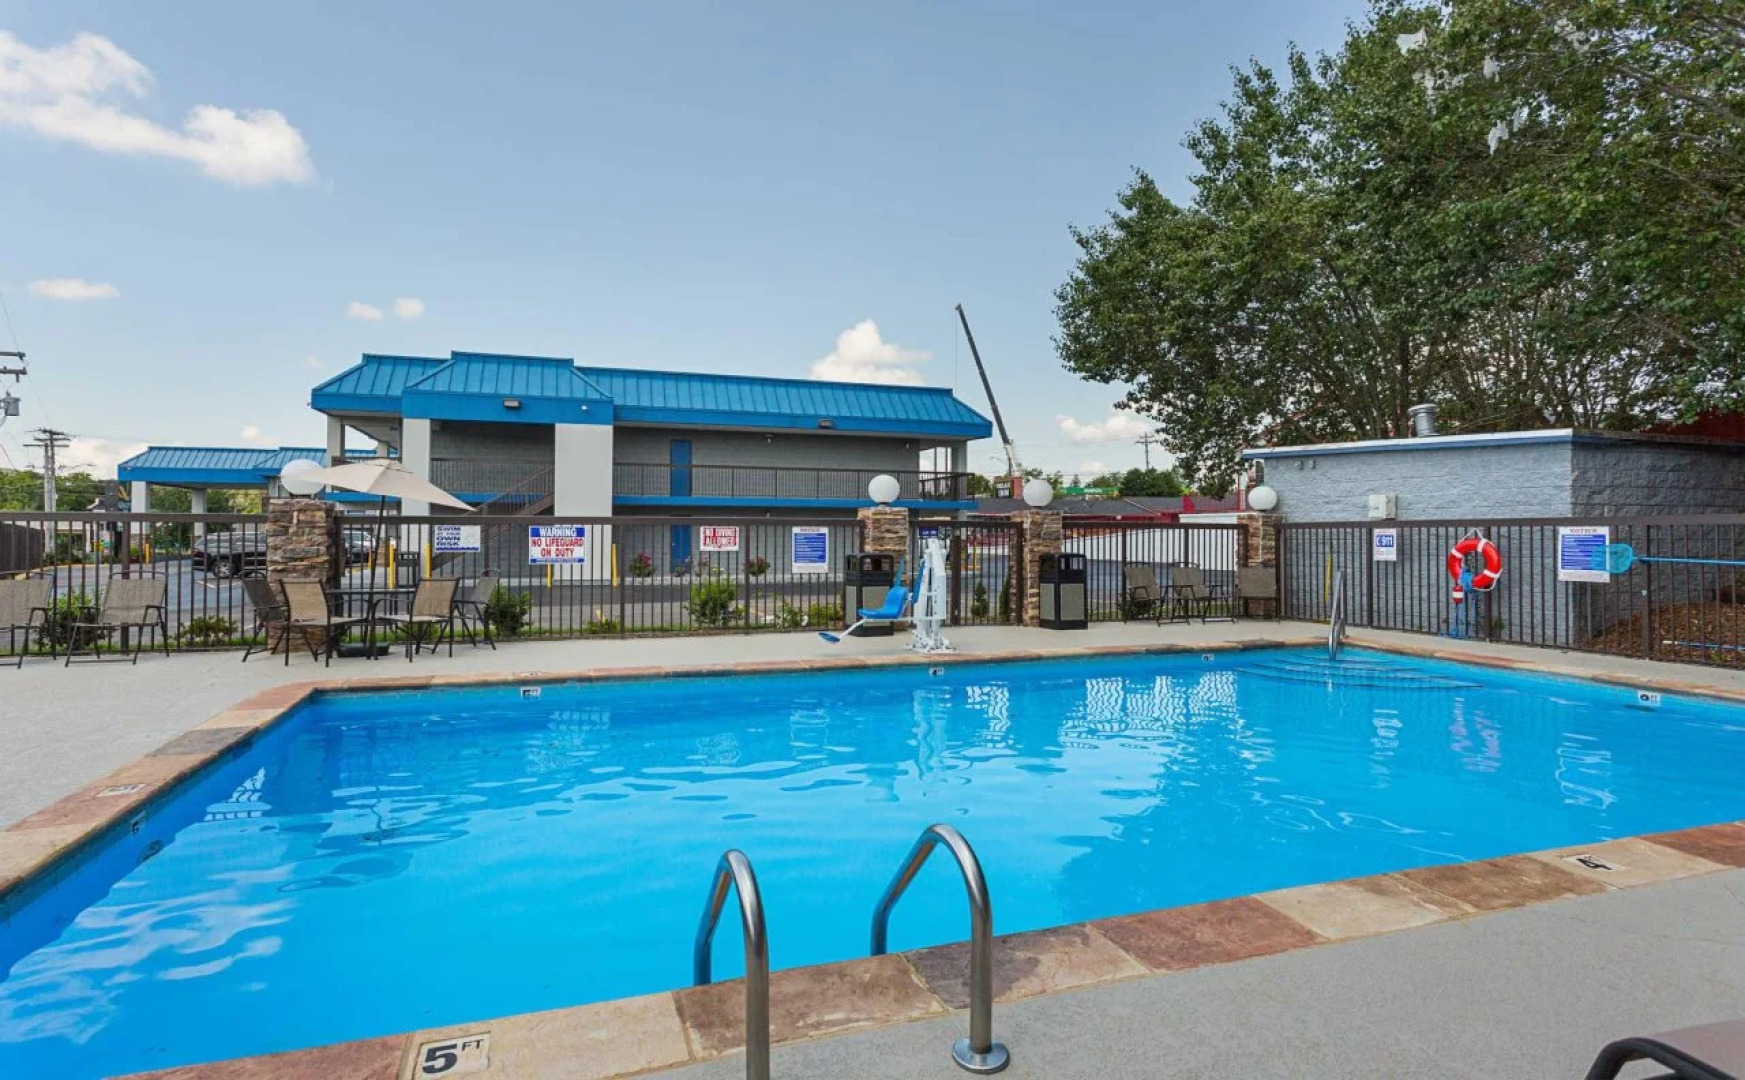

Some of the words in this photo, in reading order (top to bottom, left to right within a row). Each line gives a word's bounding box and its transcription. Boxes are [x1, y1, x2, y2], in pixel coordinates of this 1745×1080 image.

[540, 527, 578, 537] WARNING
[531, 538, 542, 547] NO
[545, 538, 584, 547] LIFEGUARD
[541, 548, 551, 557] ON
[555, 548, 574, 557] DUTY
[422, 1043, 457, 1074] 5
[462, 1038, 485, 1051] FT
